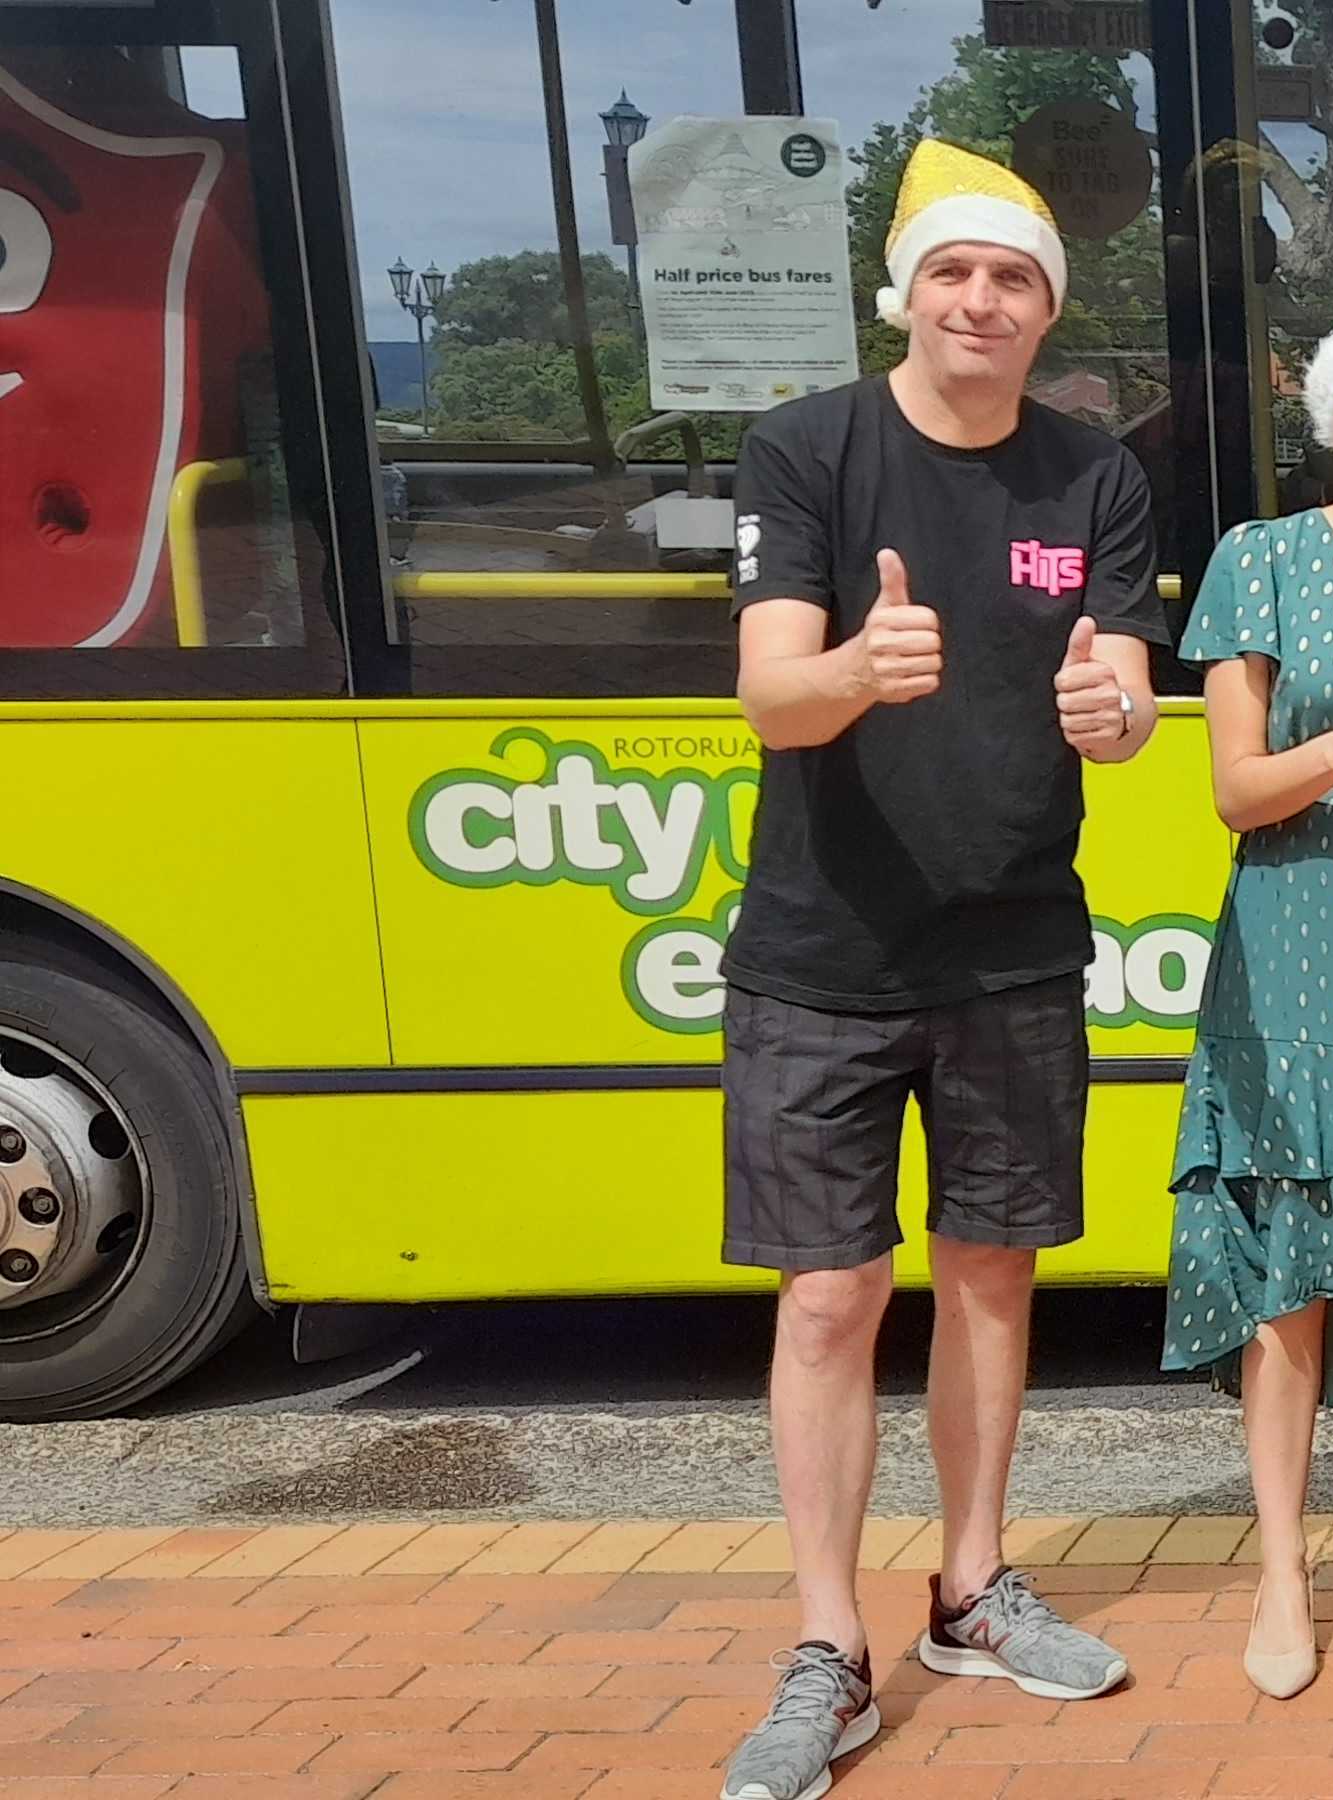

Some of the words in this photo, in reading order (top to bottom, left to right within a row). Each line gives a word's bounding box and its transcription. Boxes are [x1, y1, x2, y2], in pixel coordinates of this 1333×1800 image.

[654, 268, 690, 283] Half
[696, 268, 743, 284] price
[748, 268, 781, 283] bus
[786, 268, 832, 283] fares
[614, 737, 758, 758] ROTORUA
